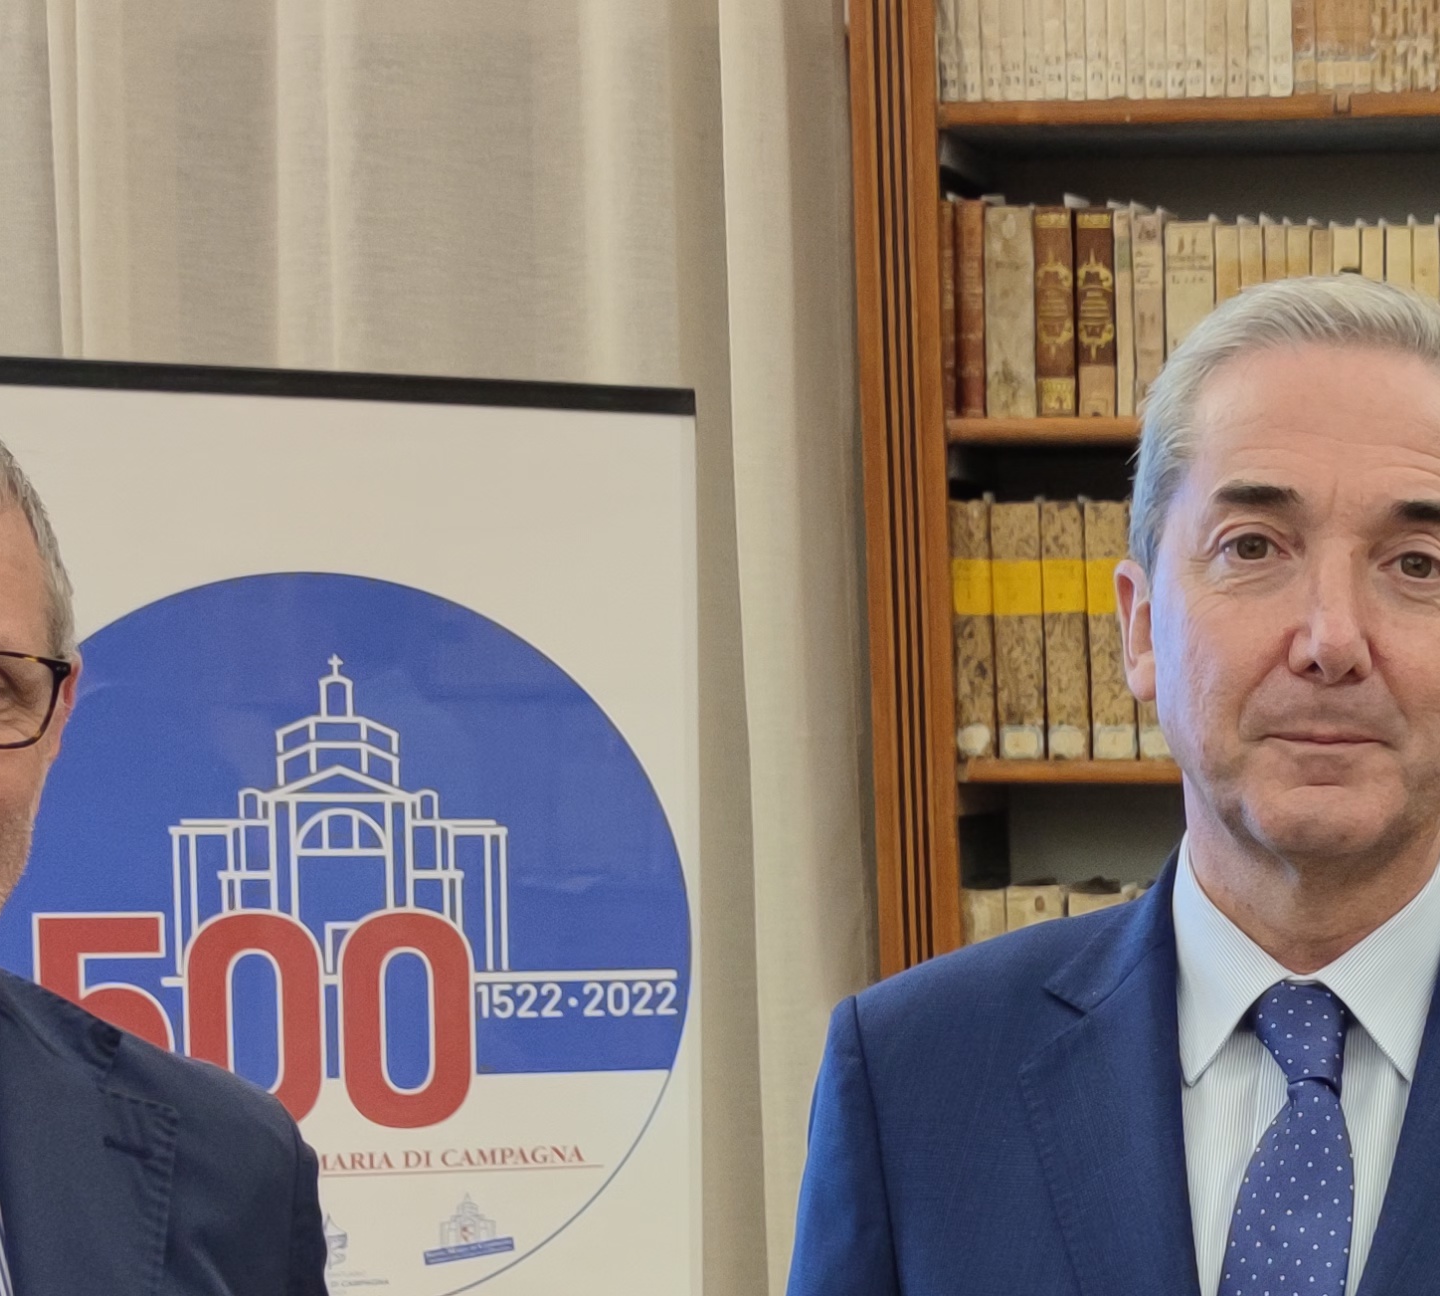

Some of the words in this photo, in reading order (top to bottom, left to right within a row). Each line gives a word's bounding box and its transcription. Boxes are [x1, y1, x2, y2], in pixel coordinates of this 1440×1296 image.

[32, 908, 475, 1129] 500
[403, 1149, 431, 1169] DI
[441, 1144, 586, 1167] CAMPAGNA
